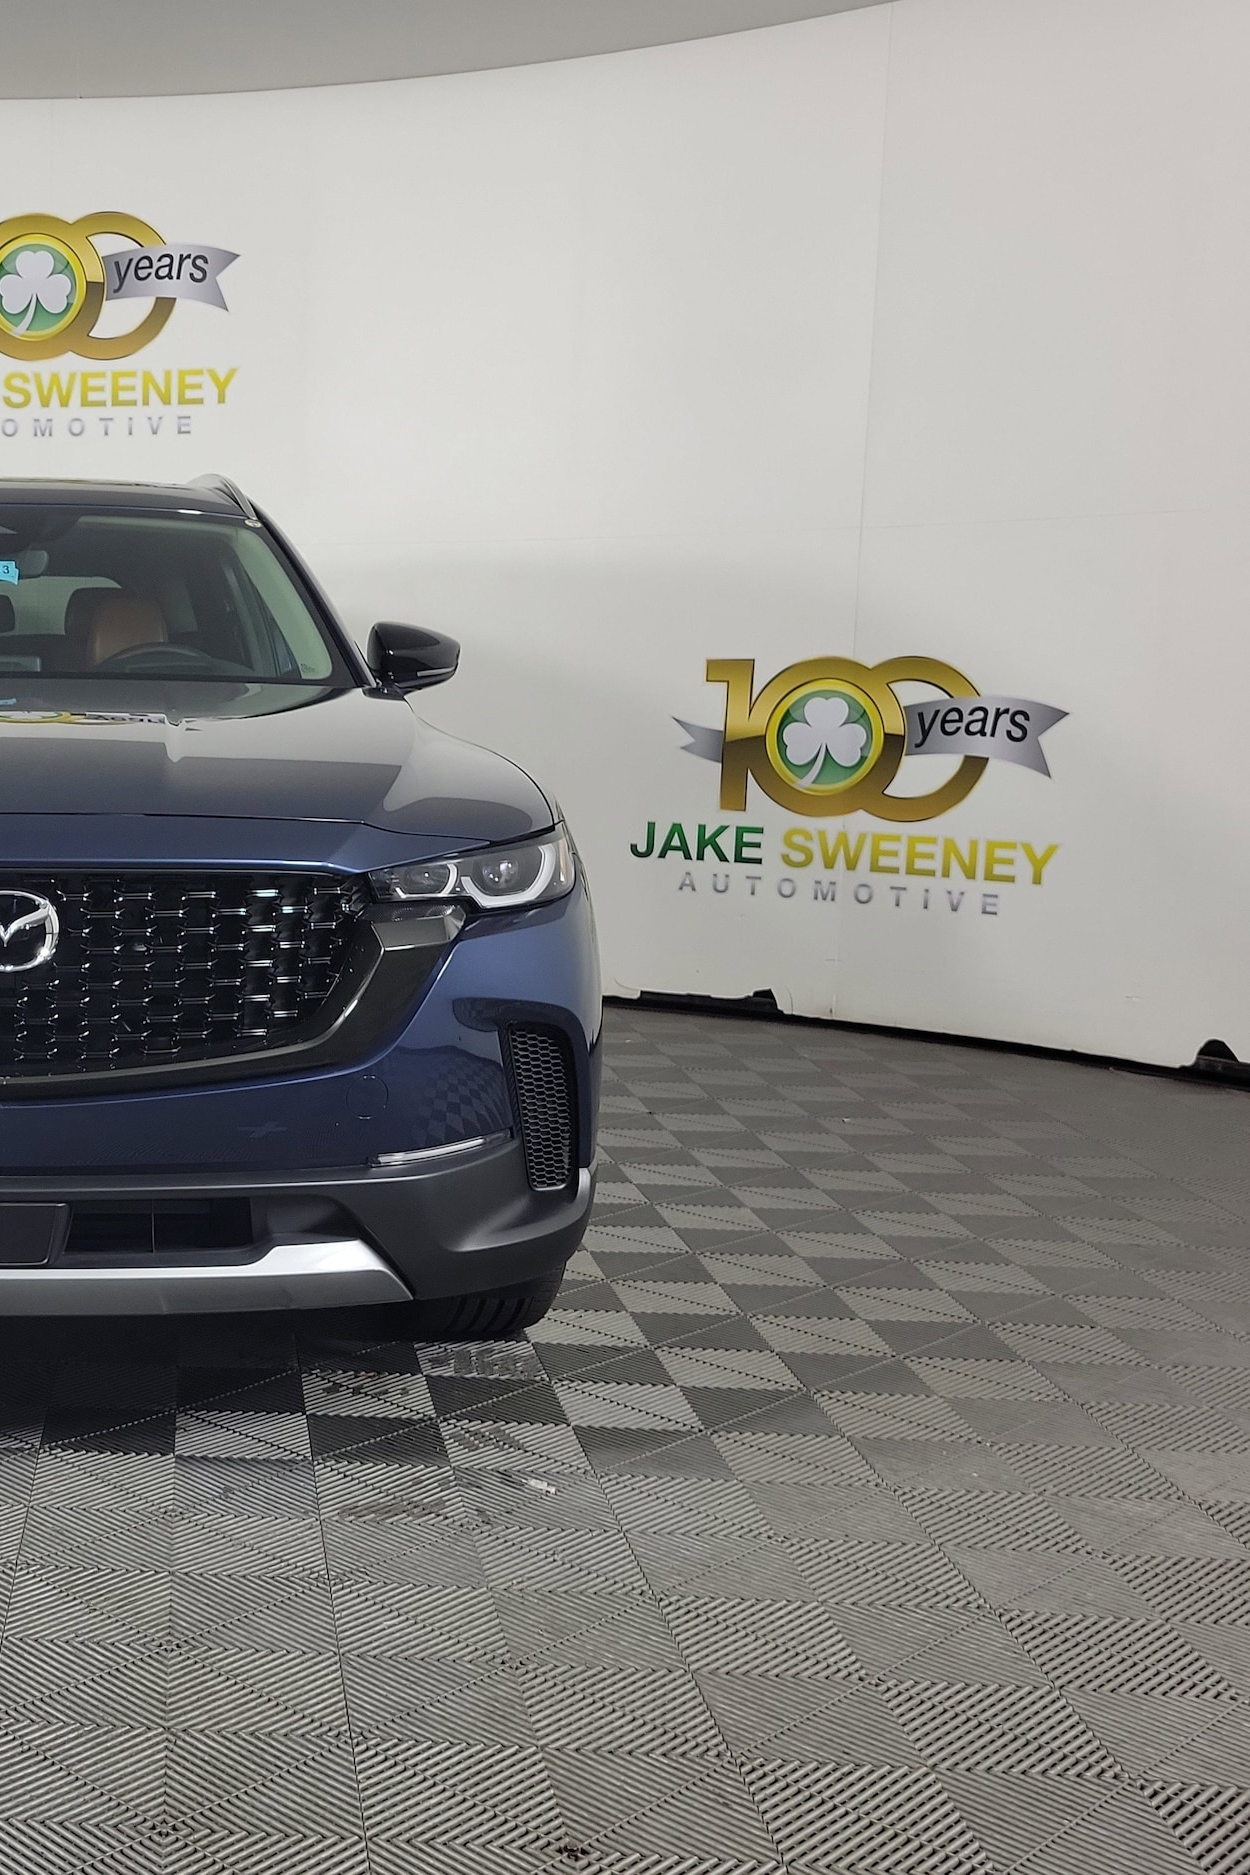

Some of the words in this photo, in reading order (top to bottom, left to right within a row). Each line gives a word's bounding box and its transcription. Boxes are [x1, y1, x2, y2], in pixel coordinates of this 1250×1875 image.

[112, 252, 210, 293] years
[2, 367, 238, 409] SWEENEY
[705, 656, 989, 823] 100
[913, 705, 1030, 749] years
[629, 821, 764, 865] JAKE
[780, 827, 1060, 886] SWEENEY
[677, 871, 999, 917] AUTOMOTIVE
